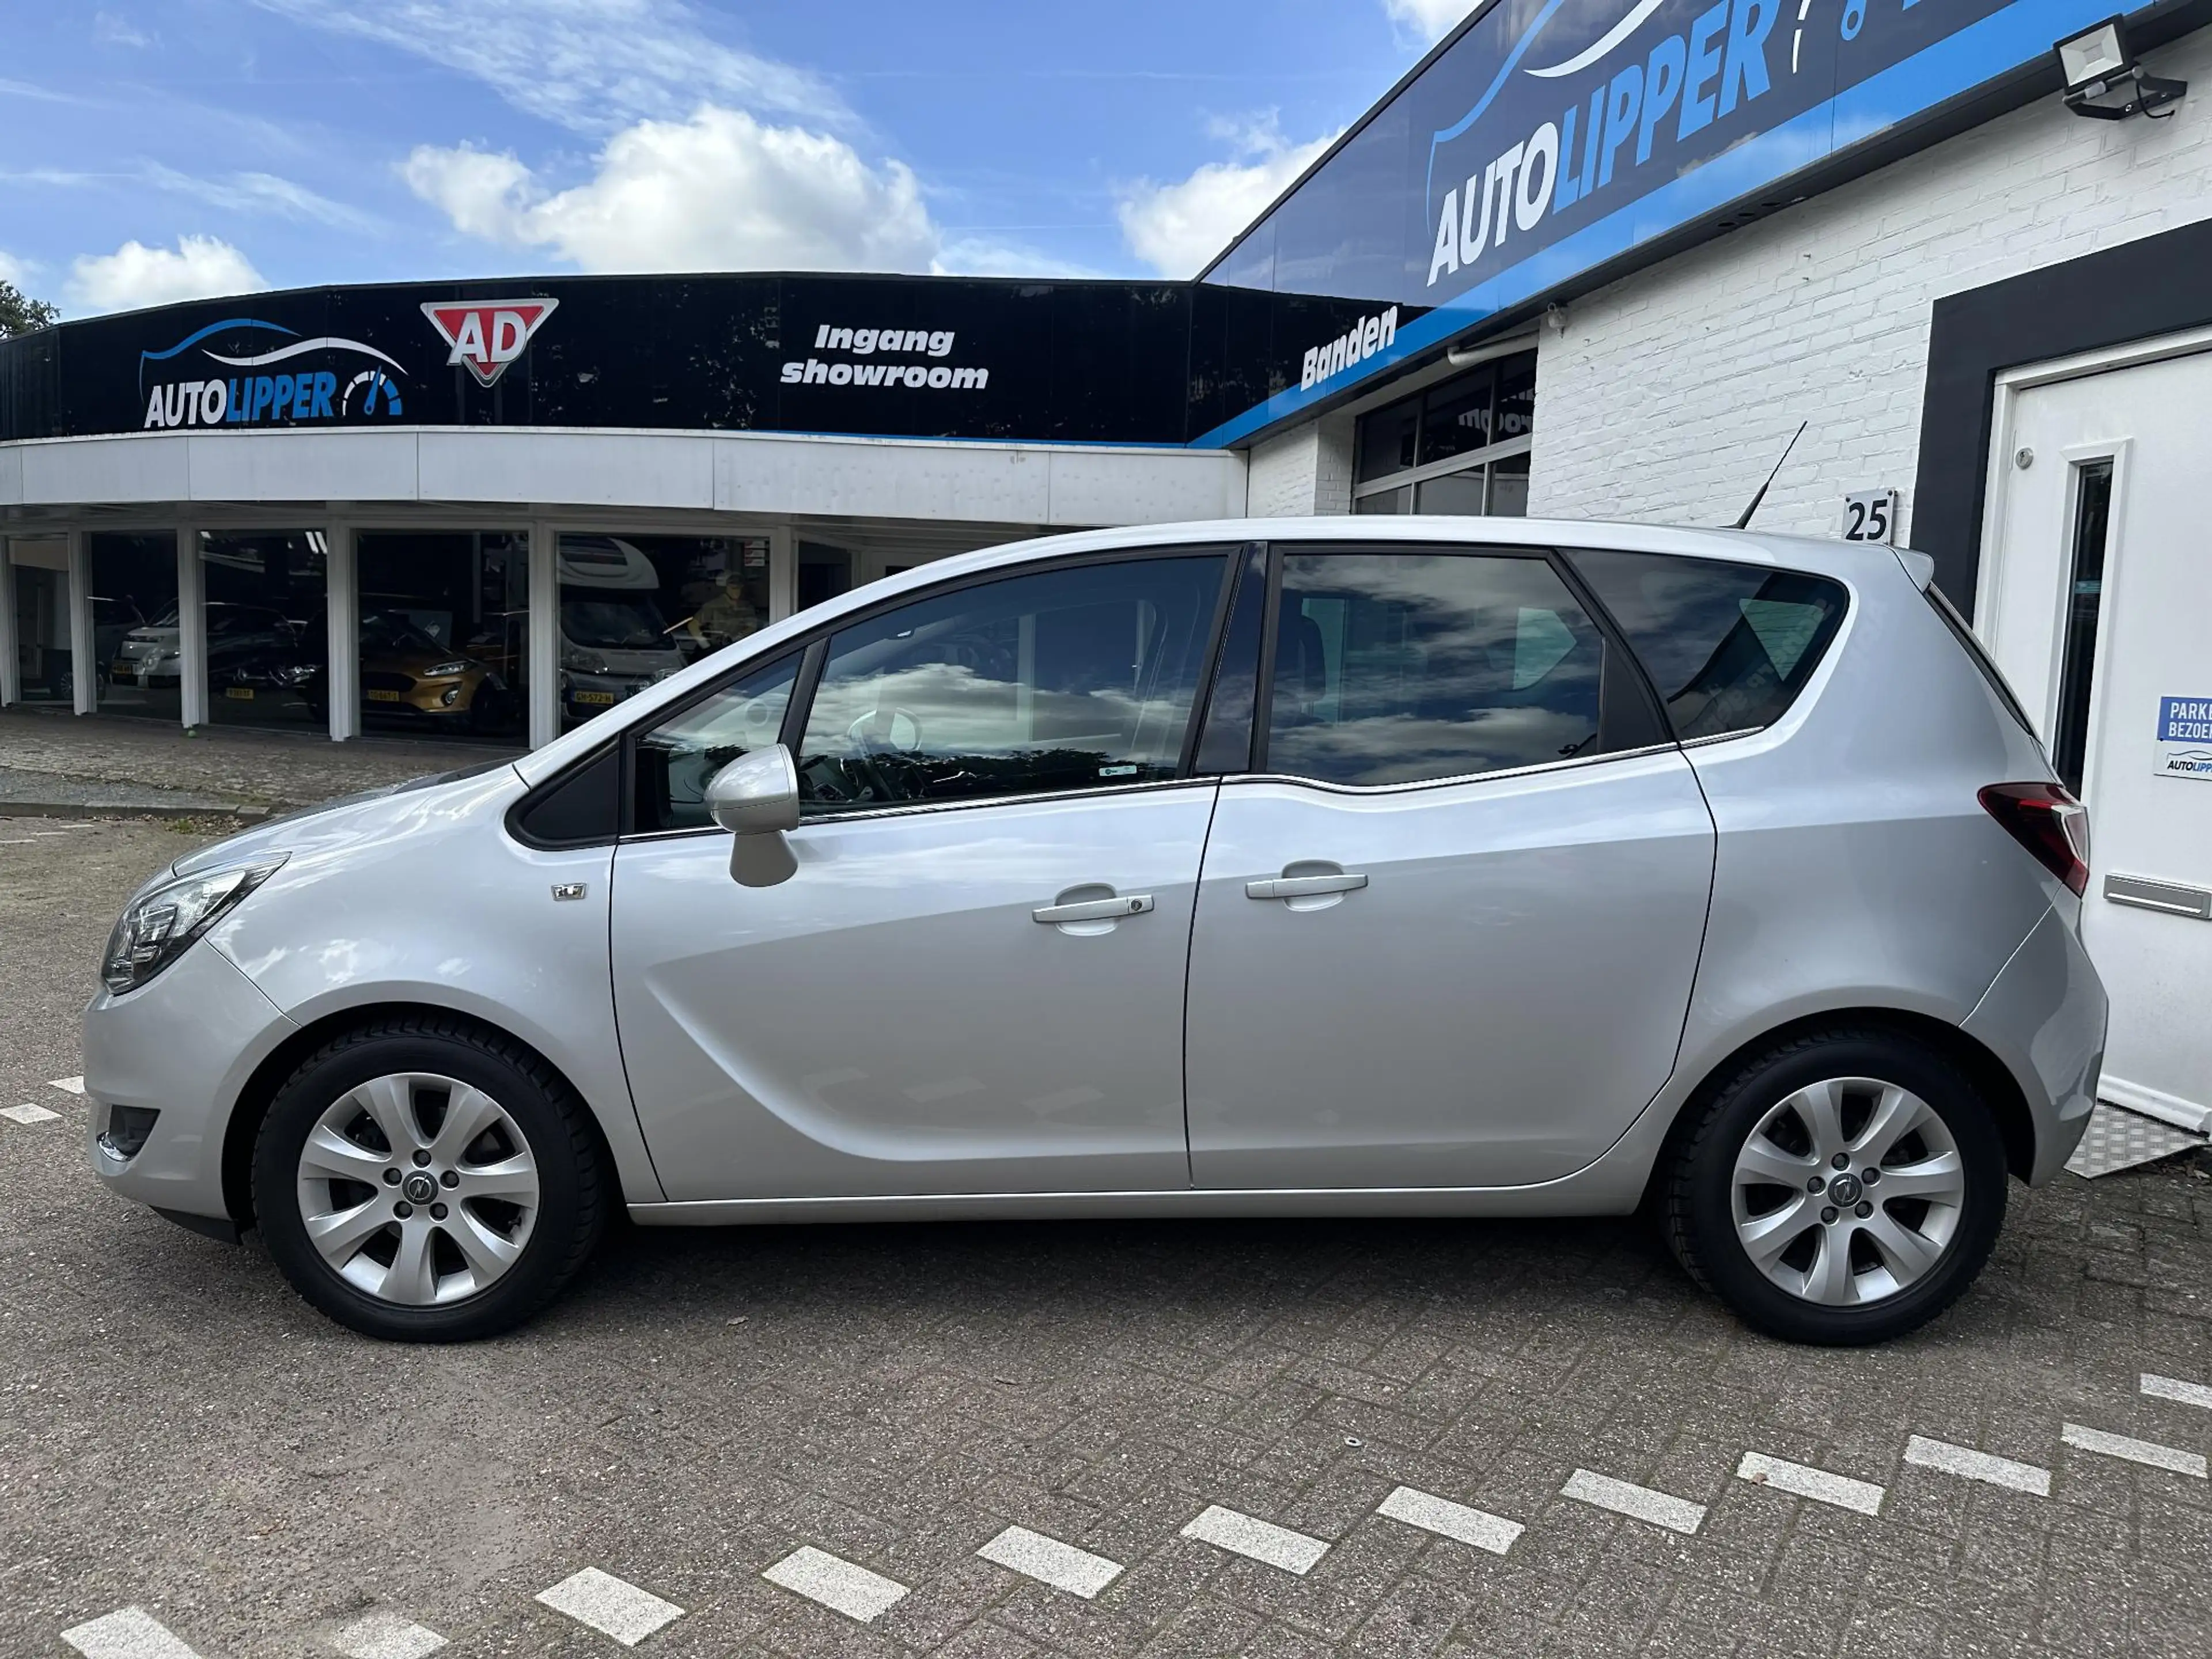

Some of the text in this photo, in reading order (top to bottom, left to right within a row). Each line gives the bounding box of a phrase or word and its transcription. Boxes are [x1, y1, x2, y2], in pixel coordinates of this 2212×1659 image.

[1426, 0, 1778, 287] AUTOLIPPER
[447, 310, 528, 366] AD
[815, 324, 955, 357] Ingang
[1300, 305, 1397, 392] Banden
[143, 371, 337, 429] AUTOLIPPER
[780, 358, 990, 390] showroom
[1845, 498, 1888, 541] 25
